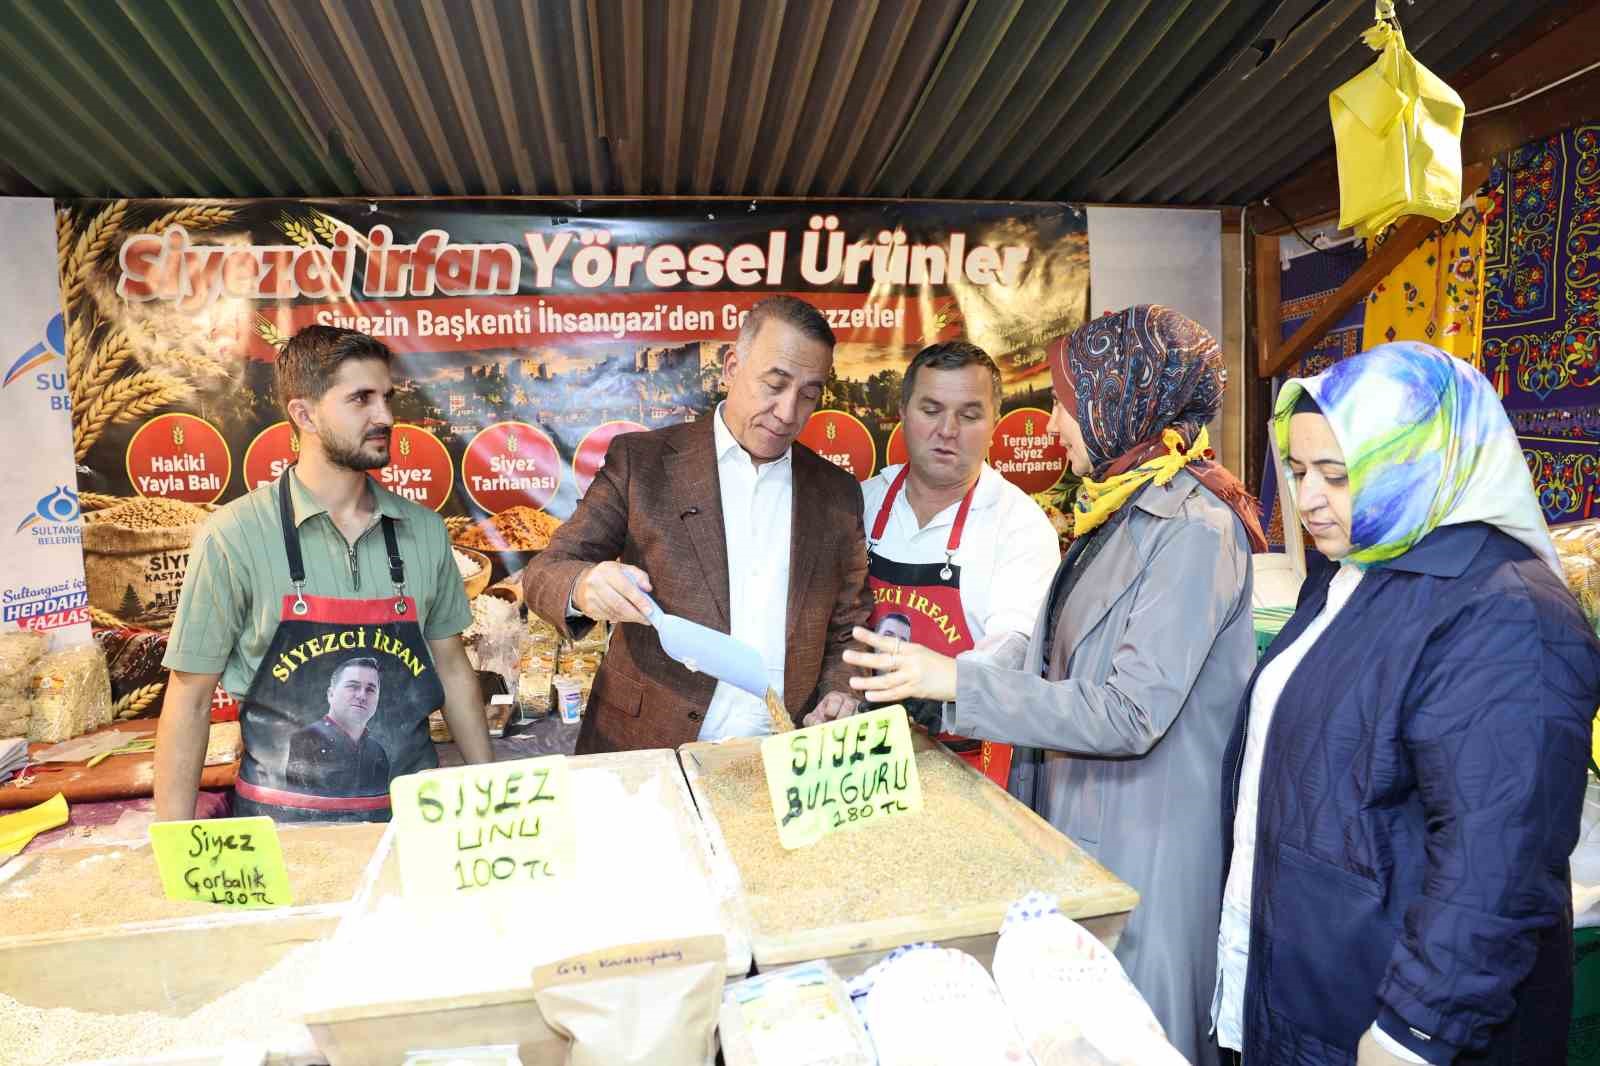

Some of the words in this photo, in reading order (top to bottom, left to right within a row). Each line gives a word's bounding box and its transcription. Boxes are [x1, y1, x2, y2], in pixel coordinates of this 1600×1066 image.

[117, 224, 355, 310] Siyezci
[525, 229, 787, 290] Yöresel
[800, 214, 1030, 287] Ürünler
[416, 306, 532, 342] Başkenti
[820, 304, 905, 330] zzetler
[151, 453, 206, 473] Hakiki
[489, 454, 536, 474] Siyez
[1014, 446, 1043, 462] Siyez
[138, 476, 184, 495] Yayla
[188, 473, 220, 491] Balı
[380, 464, 432, 486] Siyez
[471, 475, 555, 491] Tarhanası
[2, 581, 70, 604] Sultangazi
[907, 589, 962, 644] İRFAN
[272, 627, 366, 683] SİYEZCİ
[374, 628, 427, 678] İRFAN
[782, 758, 908, 828] BULGURU
[833, 804, 874, 828] 180
[880, 799, 908, 815] TL
[188, 824, 256, 865] Siyez
[457, 816, 541, 851] UNU
[454, 856, 516, 890] 100
